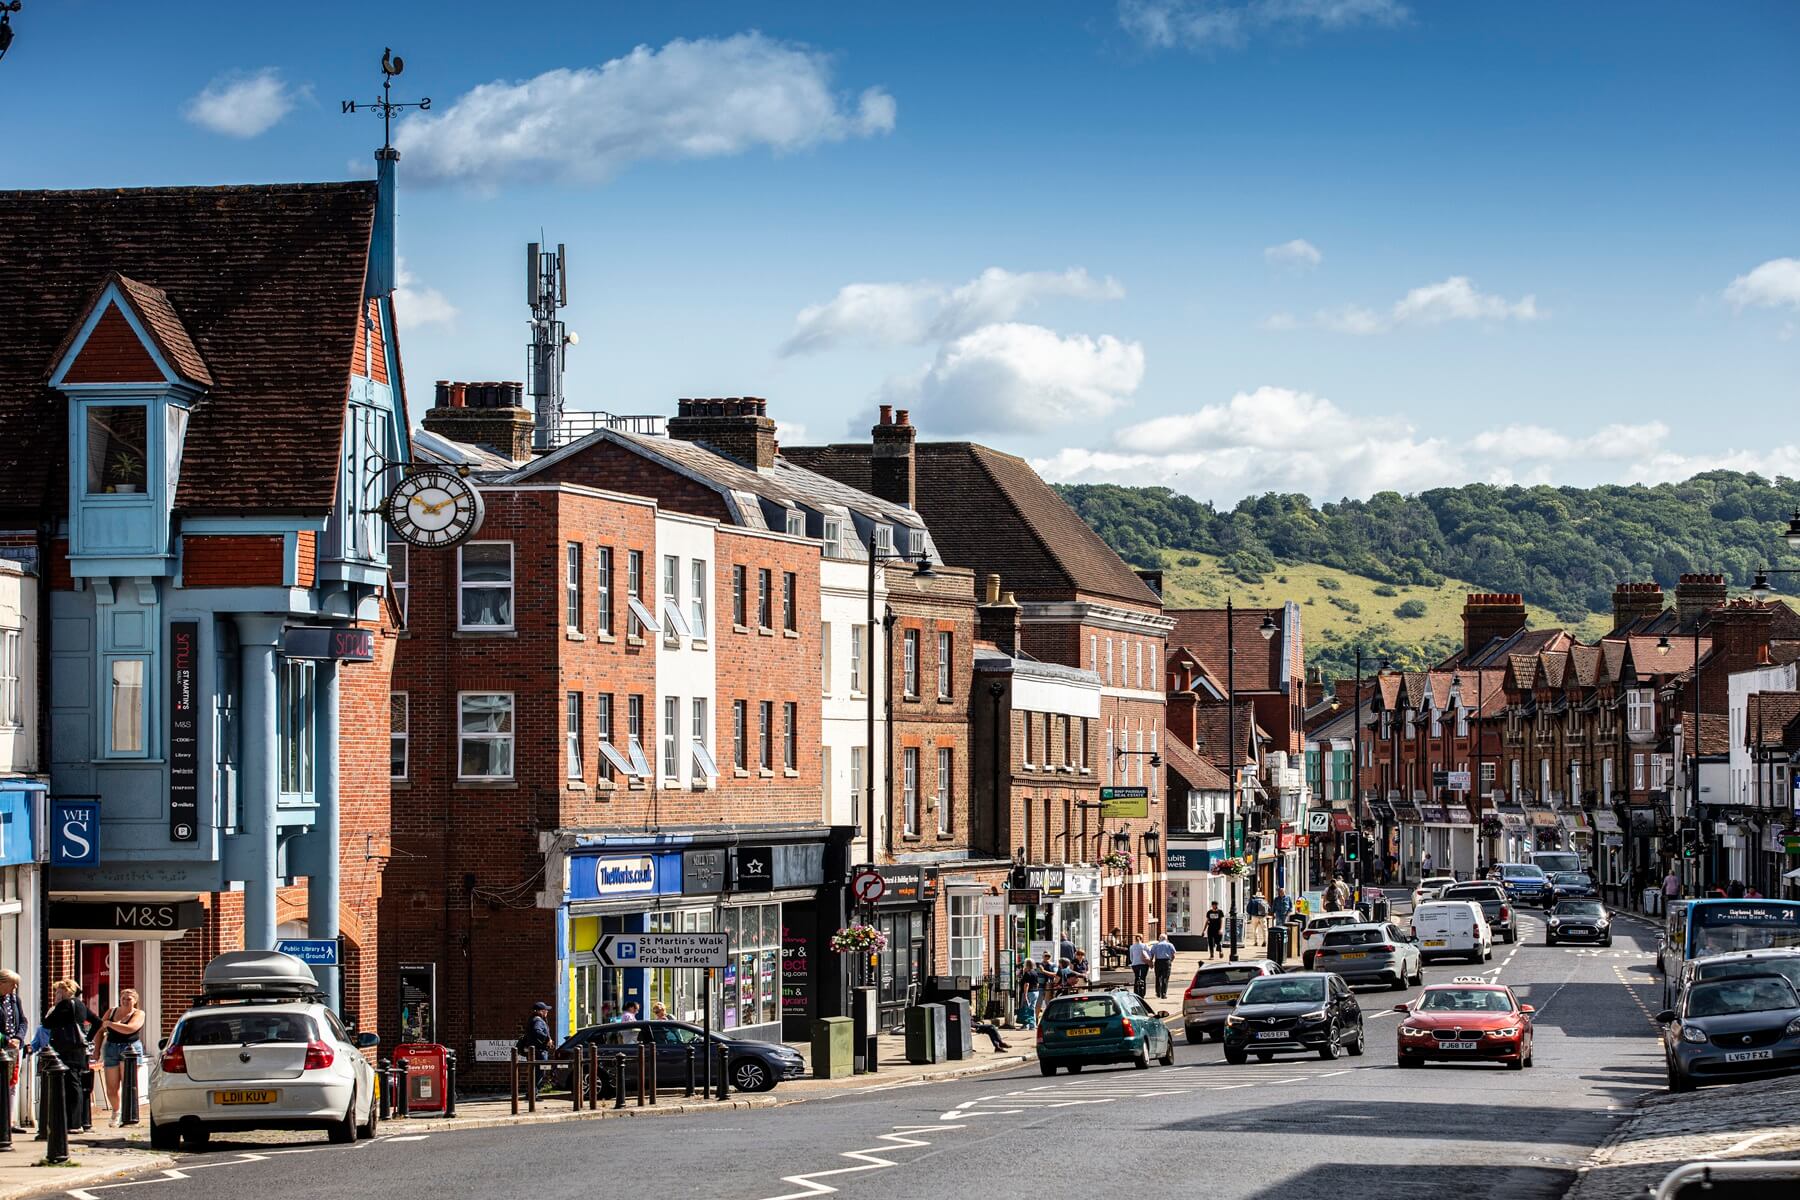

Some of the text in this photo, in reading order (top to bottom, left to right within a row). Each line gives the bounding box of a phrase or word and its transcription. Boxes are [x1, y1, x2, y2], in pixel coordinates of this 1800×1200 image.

[183, 670, 190, 678] ST
[62, 821, 90, 858] S
[600, 863, 652, 886] TheWorks.co.uk
[116, 906, 174, 926] M&S
[1782, 910, 1794, 920] 21
[684, 947, 719, 955] ground
[782, 946, 806, 956] er &
[640, 956, 670, 964] Friday
[784, 959, 806, 970] ect
[1753, 1050, 1769, 1059] FXZ
